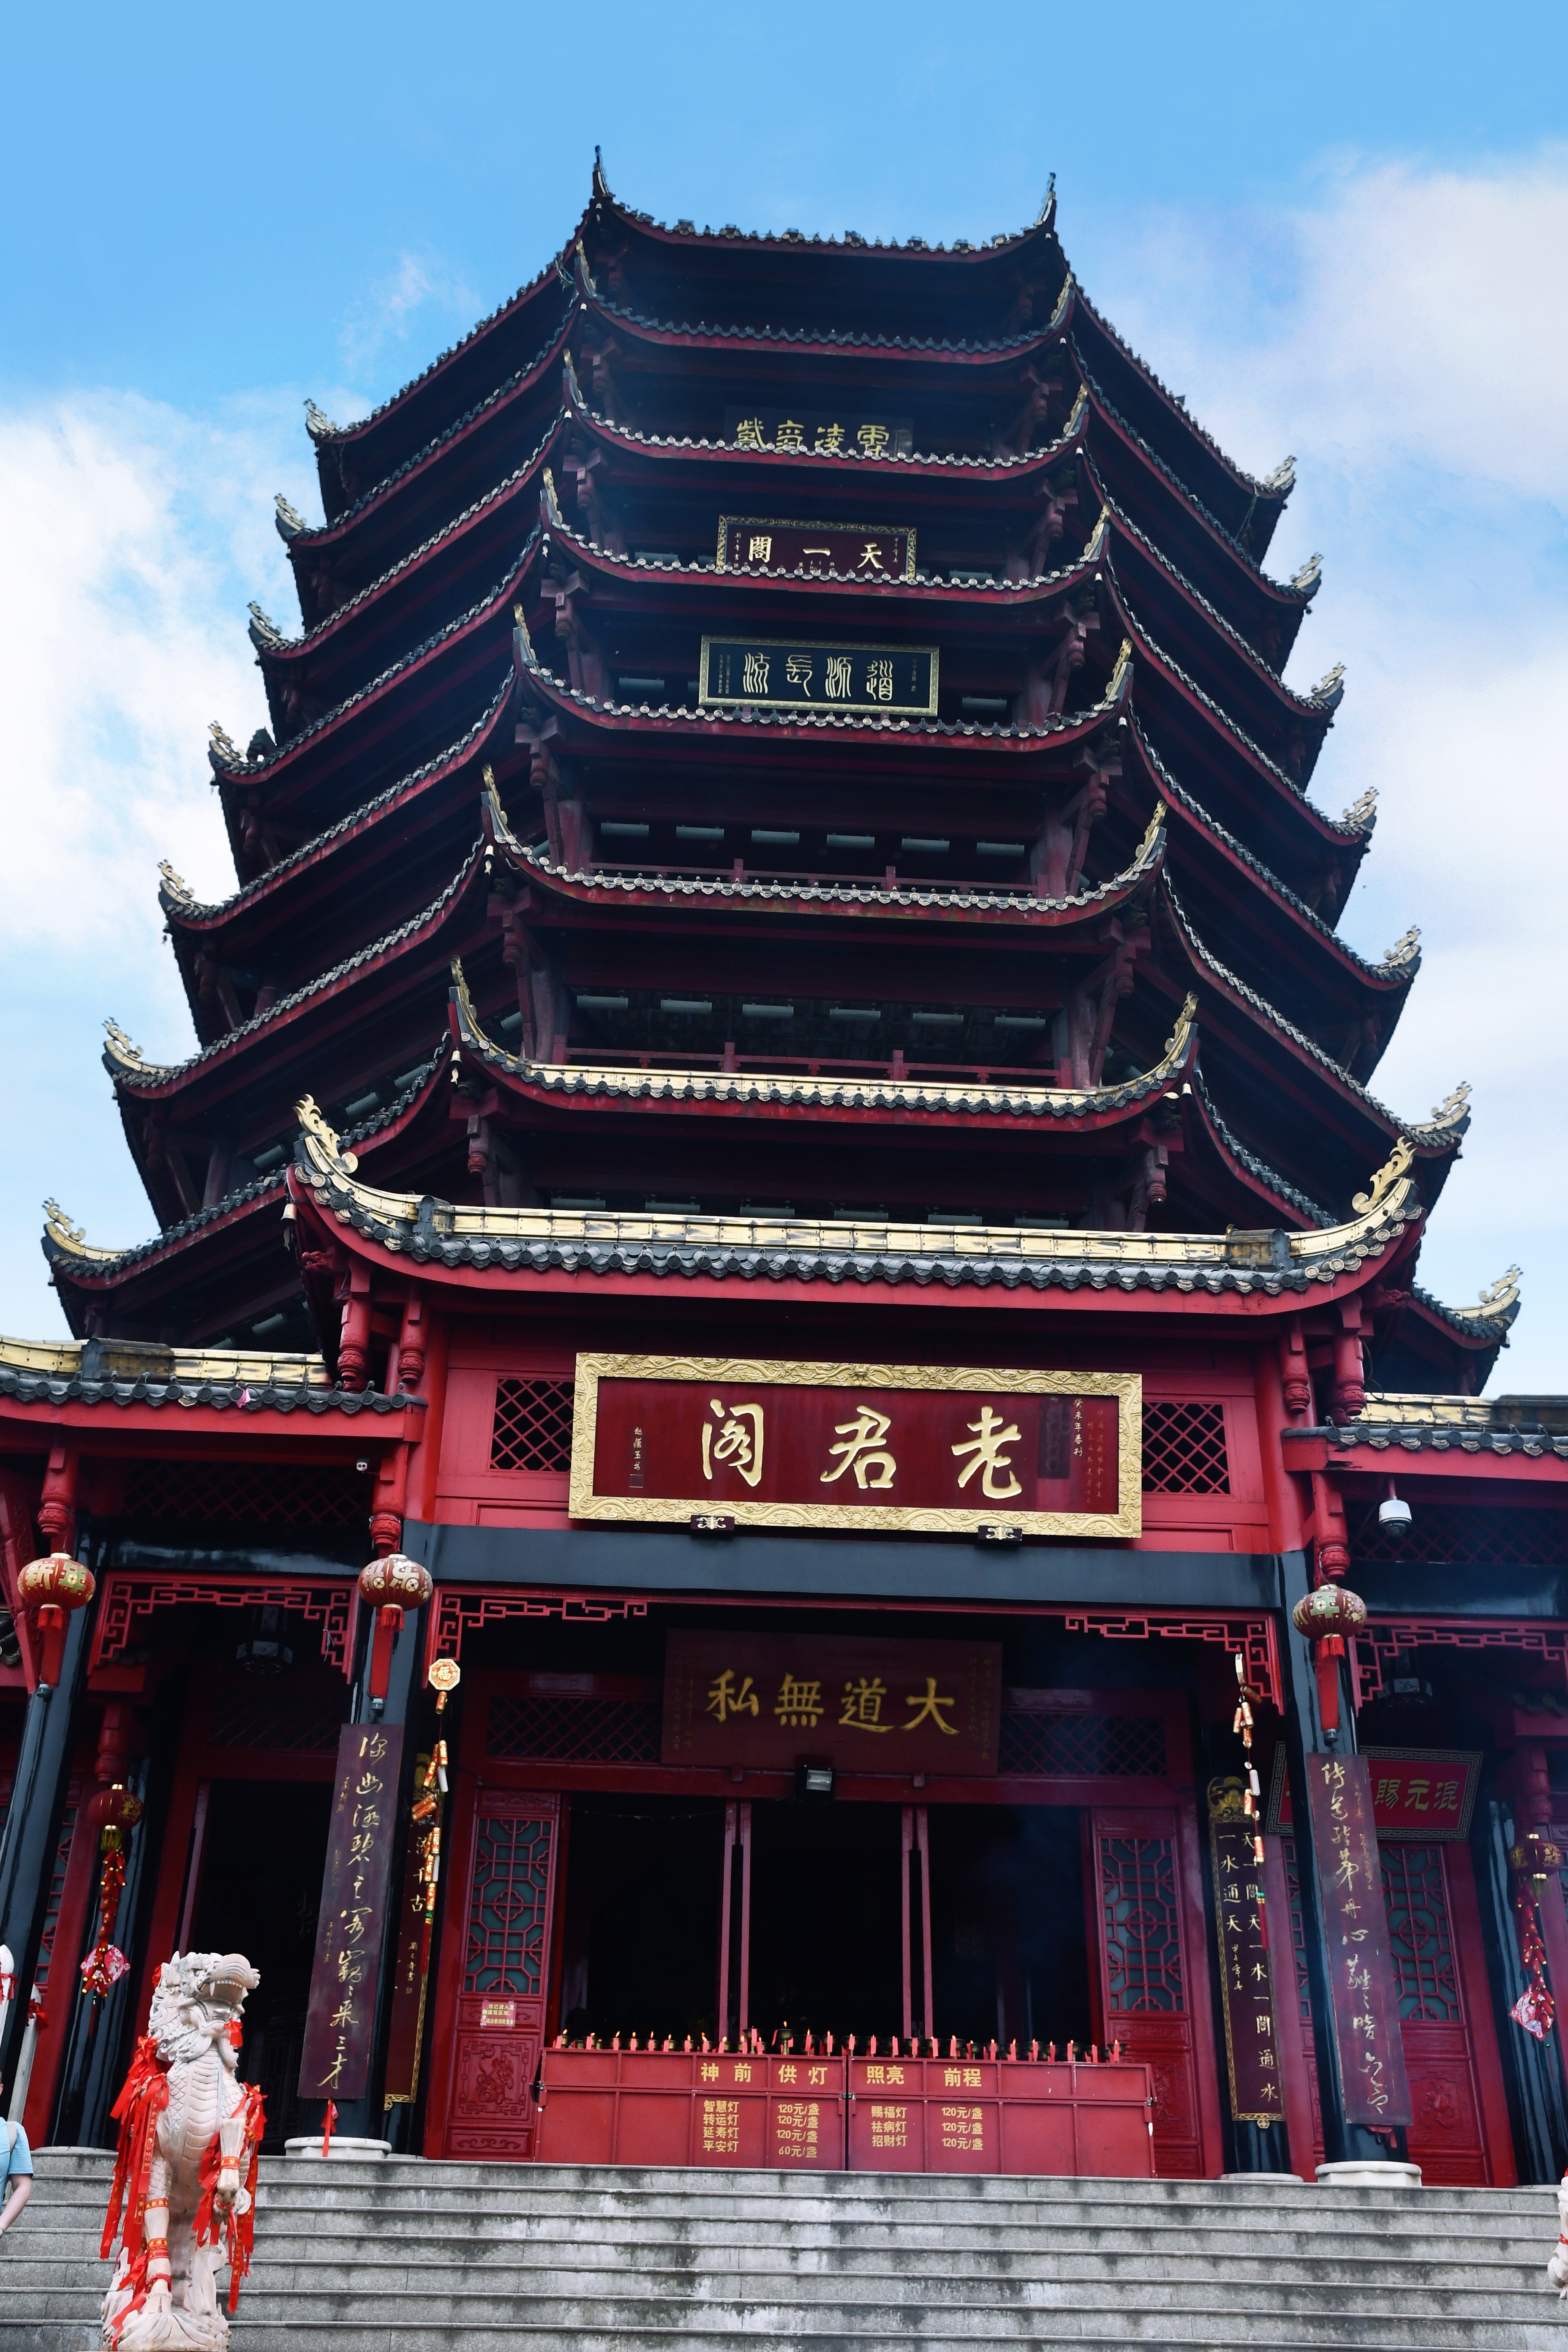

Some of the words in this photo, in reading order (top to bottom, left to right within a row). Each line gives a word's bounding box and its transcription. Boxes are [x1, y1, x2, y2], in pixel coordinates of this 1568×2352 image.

[749, 535, 884, 569] 天一閣
[701, 1399, 1023, 1499] 老君阁
[437, 1666, 452, 1680] 福
[1369, 1778, 1459, 1810] 混元賜
[866, 2065, 904, 2085] 照亮
[944, 2067, 982, 2087] 前程
[703, 2099, 739, 2113] 智慧灯
[778, 2103, 819, 2115] 120元/盏
[871, 2106, 907, 2118] 赐福灯
[703, 2113, 739, 2126] 转运灯
[942, 2107, 983, 2120] 120元/盏
[777, 2115, 819, 2129] 120元/盏
[871, 2121, 907, 2133] 祛病灯
[942, 2121, 983, 2134] 120元/盏
[703, 2126, 739, 2139] 延寿灯
[776, 2129, 818, 2143] 120元/盏
[703, 2140, 739, 2153] 平安灯
[871, 2134, 907, 2147] 招财灯
[942, 2137, 983, 2151] 120元/盏
[779, 2145, 817, 2158] 60元/盏
